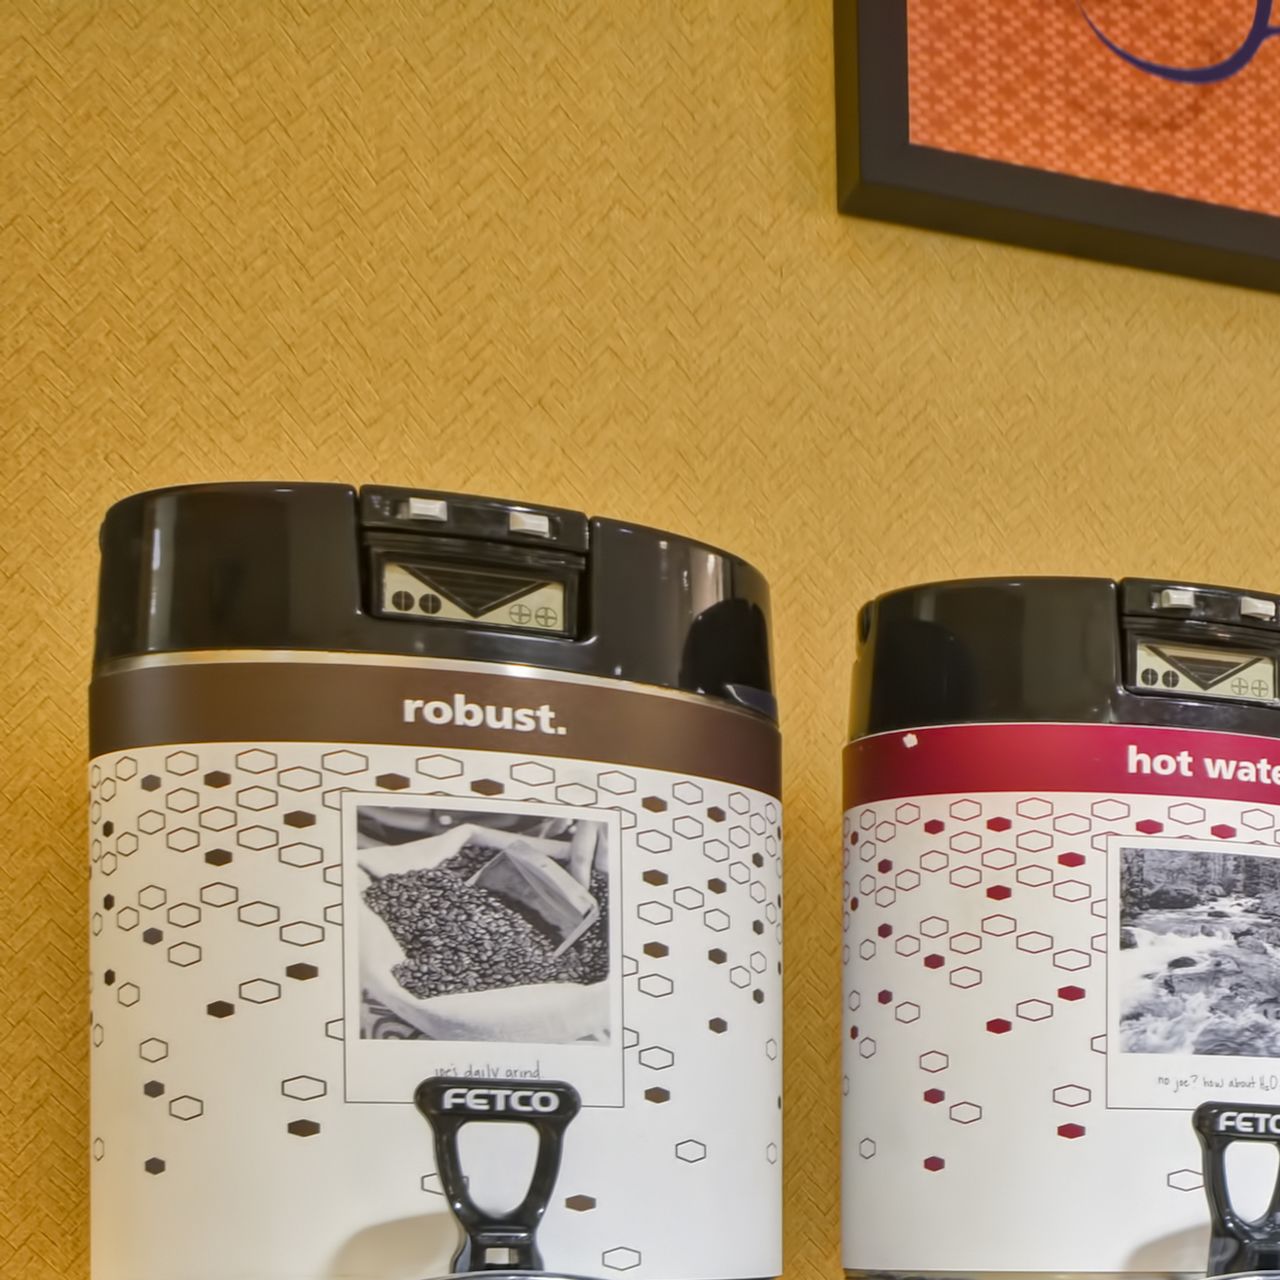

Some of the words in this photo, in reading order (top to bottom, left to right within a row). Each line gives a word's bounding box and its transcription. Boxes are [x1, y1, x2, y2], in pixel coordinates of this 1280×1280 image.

[403, 693, 567, 735] robust.
[1127, 744, 1193, 777] hot
[1157, 1075, 1170, 1086] no
[1203, 1076, 1224, 1088] how
[1228, 1075, 1255, 1088] about
[442, 1088, 559, 1112] FETCO
